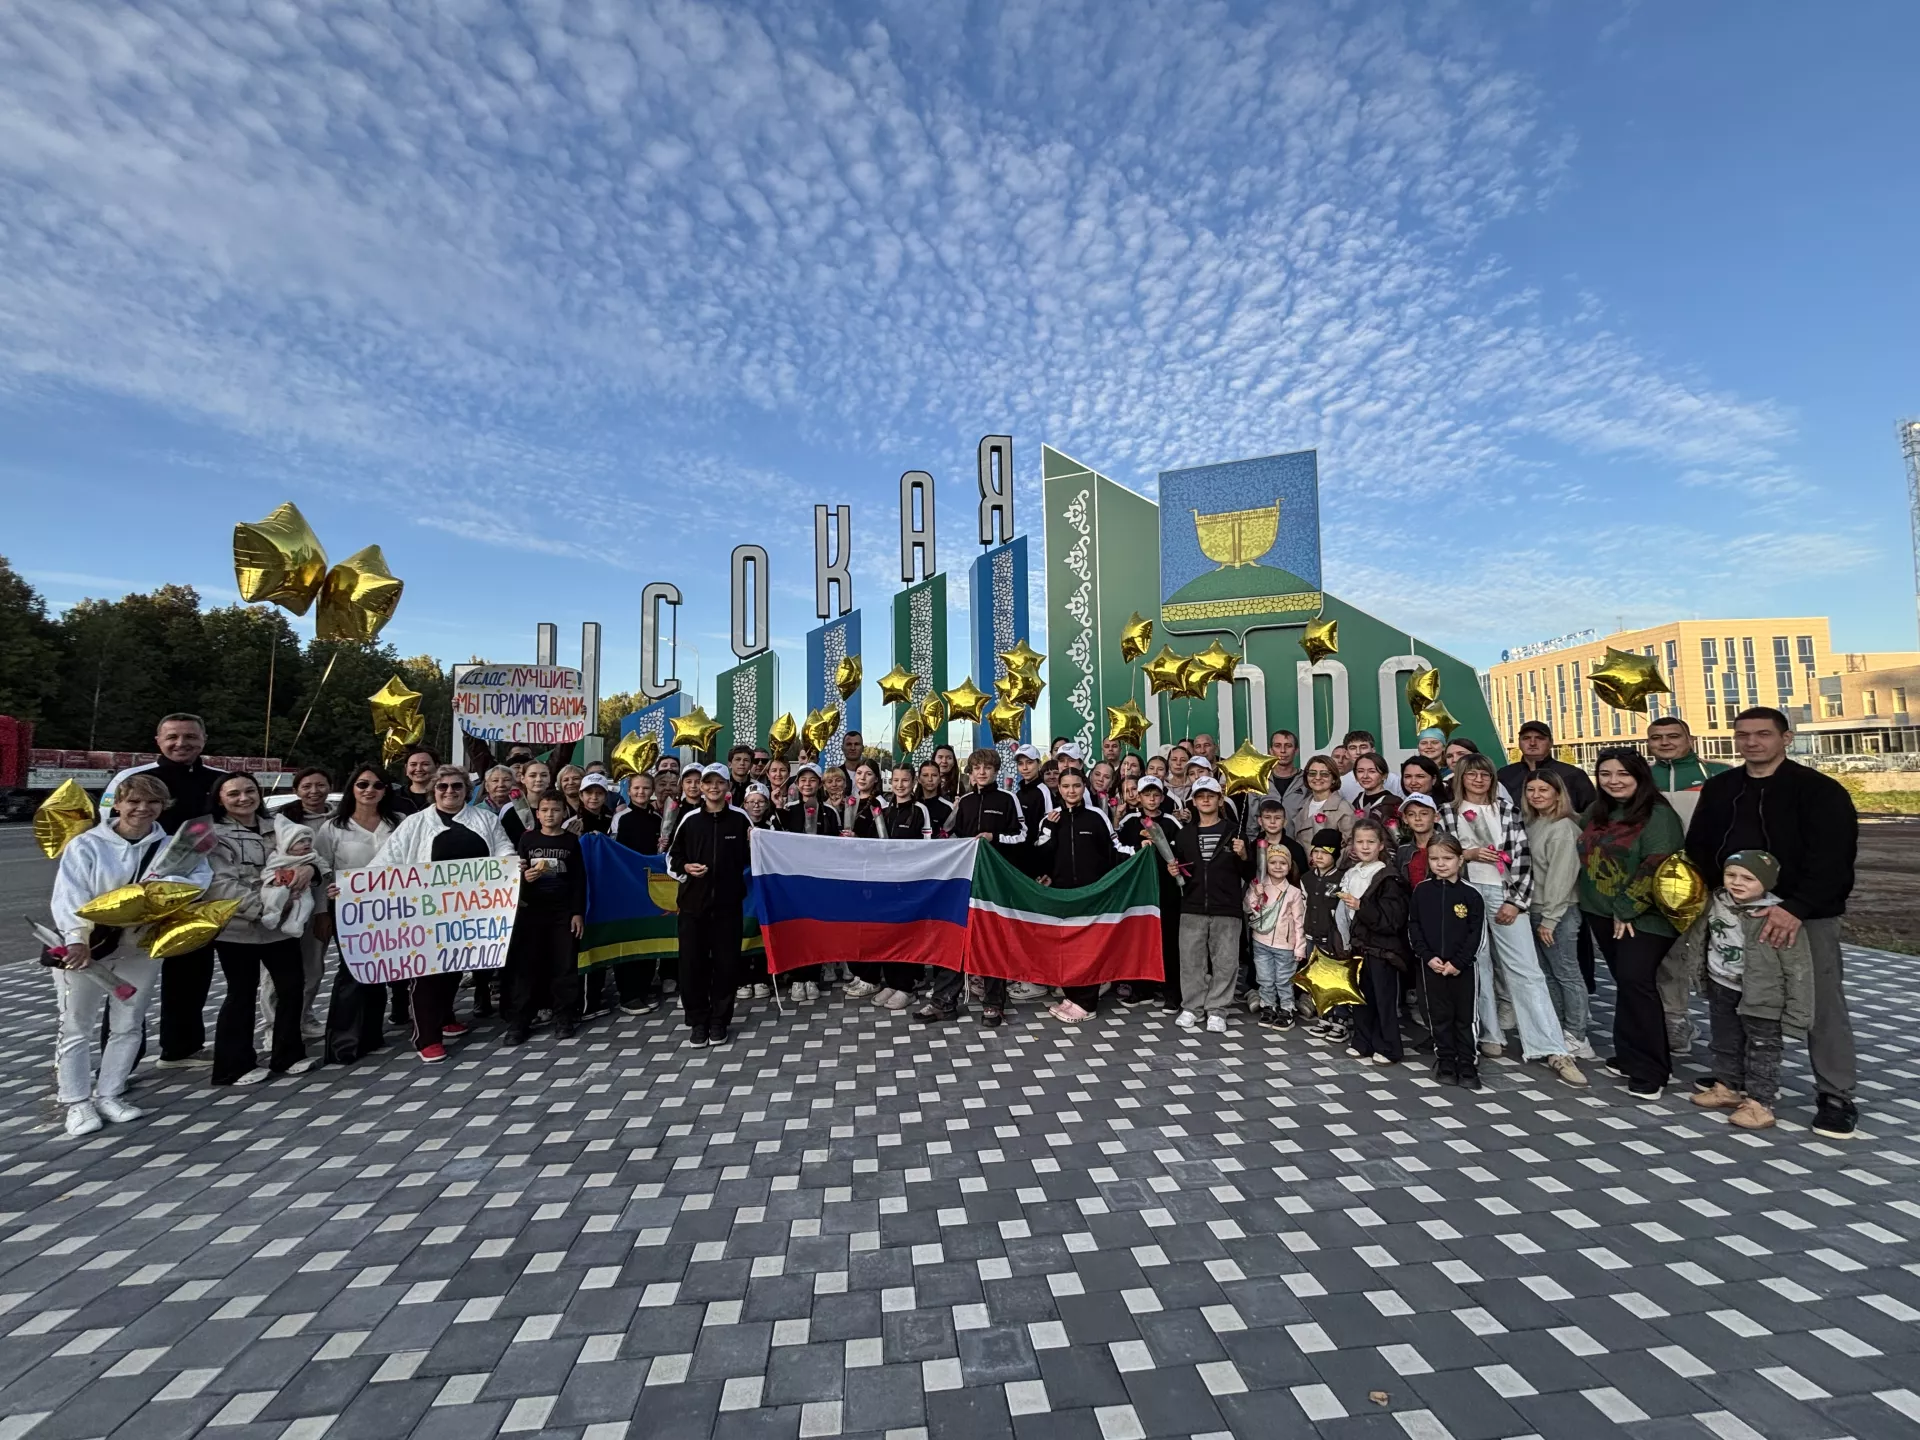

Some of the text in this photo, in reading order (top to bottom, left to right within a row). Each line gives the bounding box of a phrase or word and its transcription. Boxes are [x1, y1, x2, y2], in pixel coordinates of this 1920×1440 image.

[457, 692, 480, 714] МЫ
[483, 693, 548, 717] ГОРДИМСЯ
[512, 722, 522, 743] С
[526, 721, 584, 744] ПОБЕДОЙ
[350, 866, 429, 894] СИЛА,
[430, 858, 509, 887] ДРАЙВ,
[342, 887, 517, 926] ОГОНЬ В ГЛАЗАХ,
[341, 925, 426, 955] ТОЛЬКО
[349, 954, 427, 984] ТОЛЬКО
